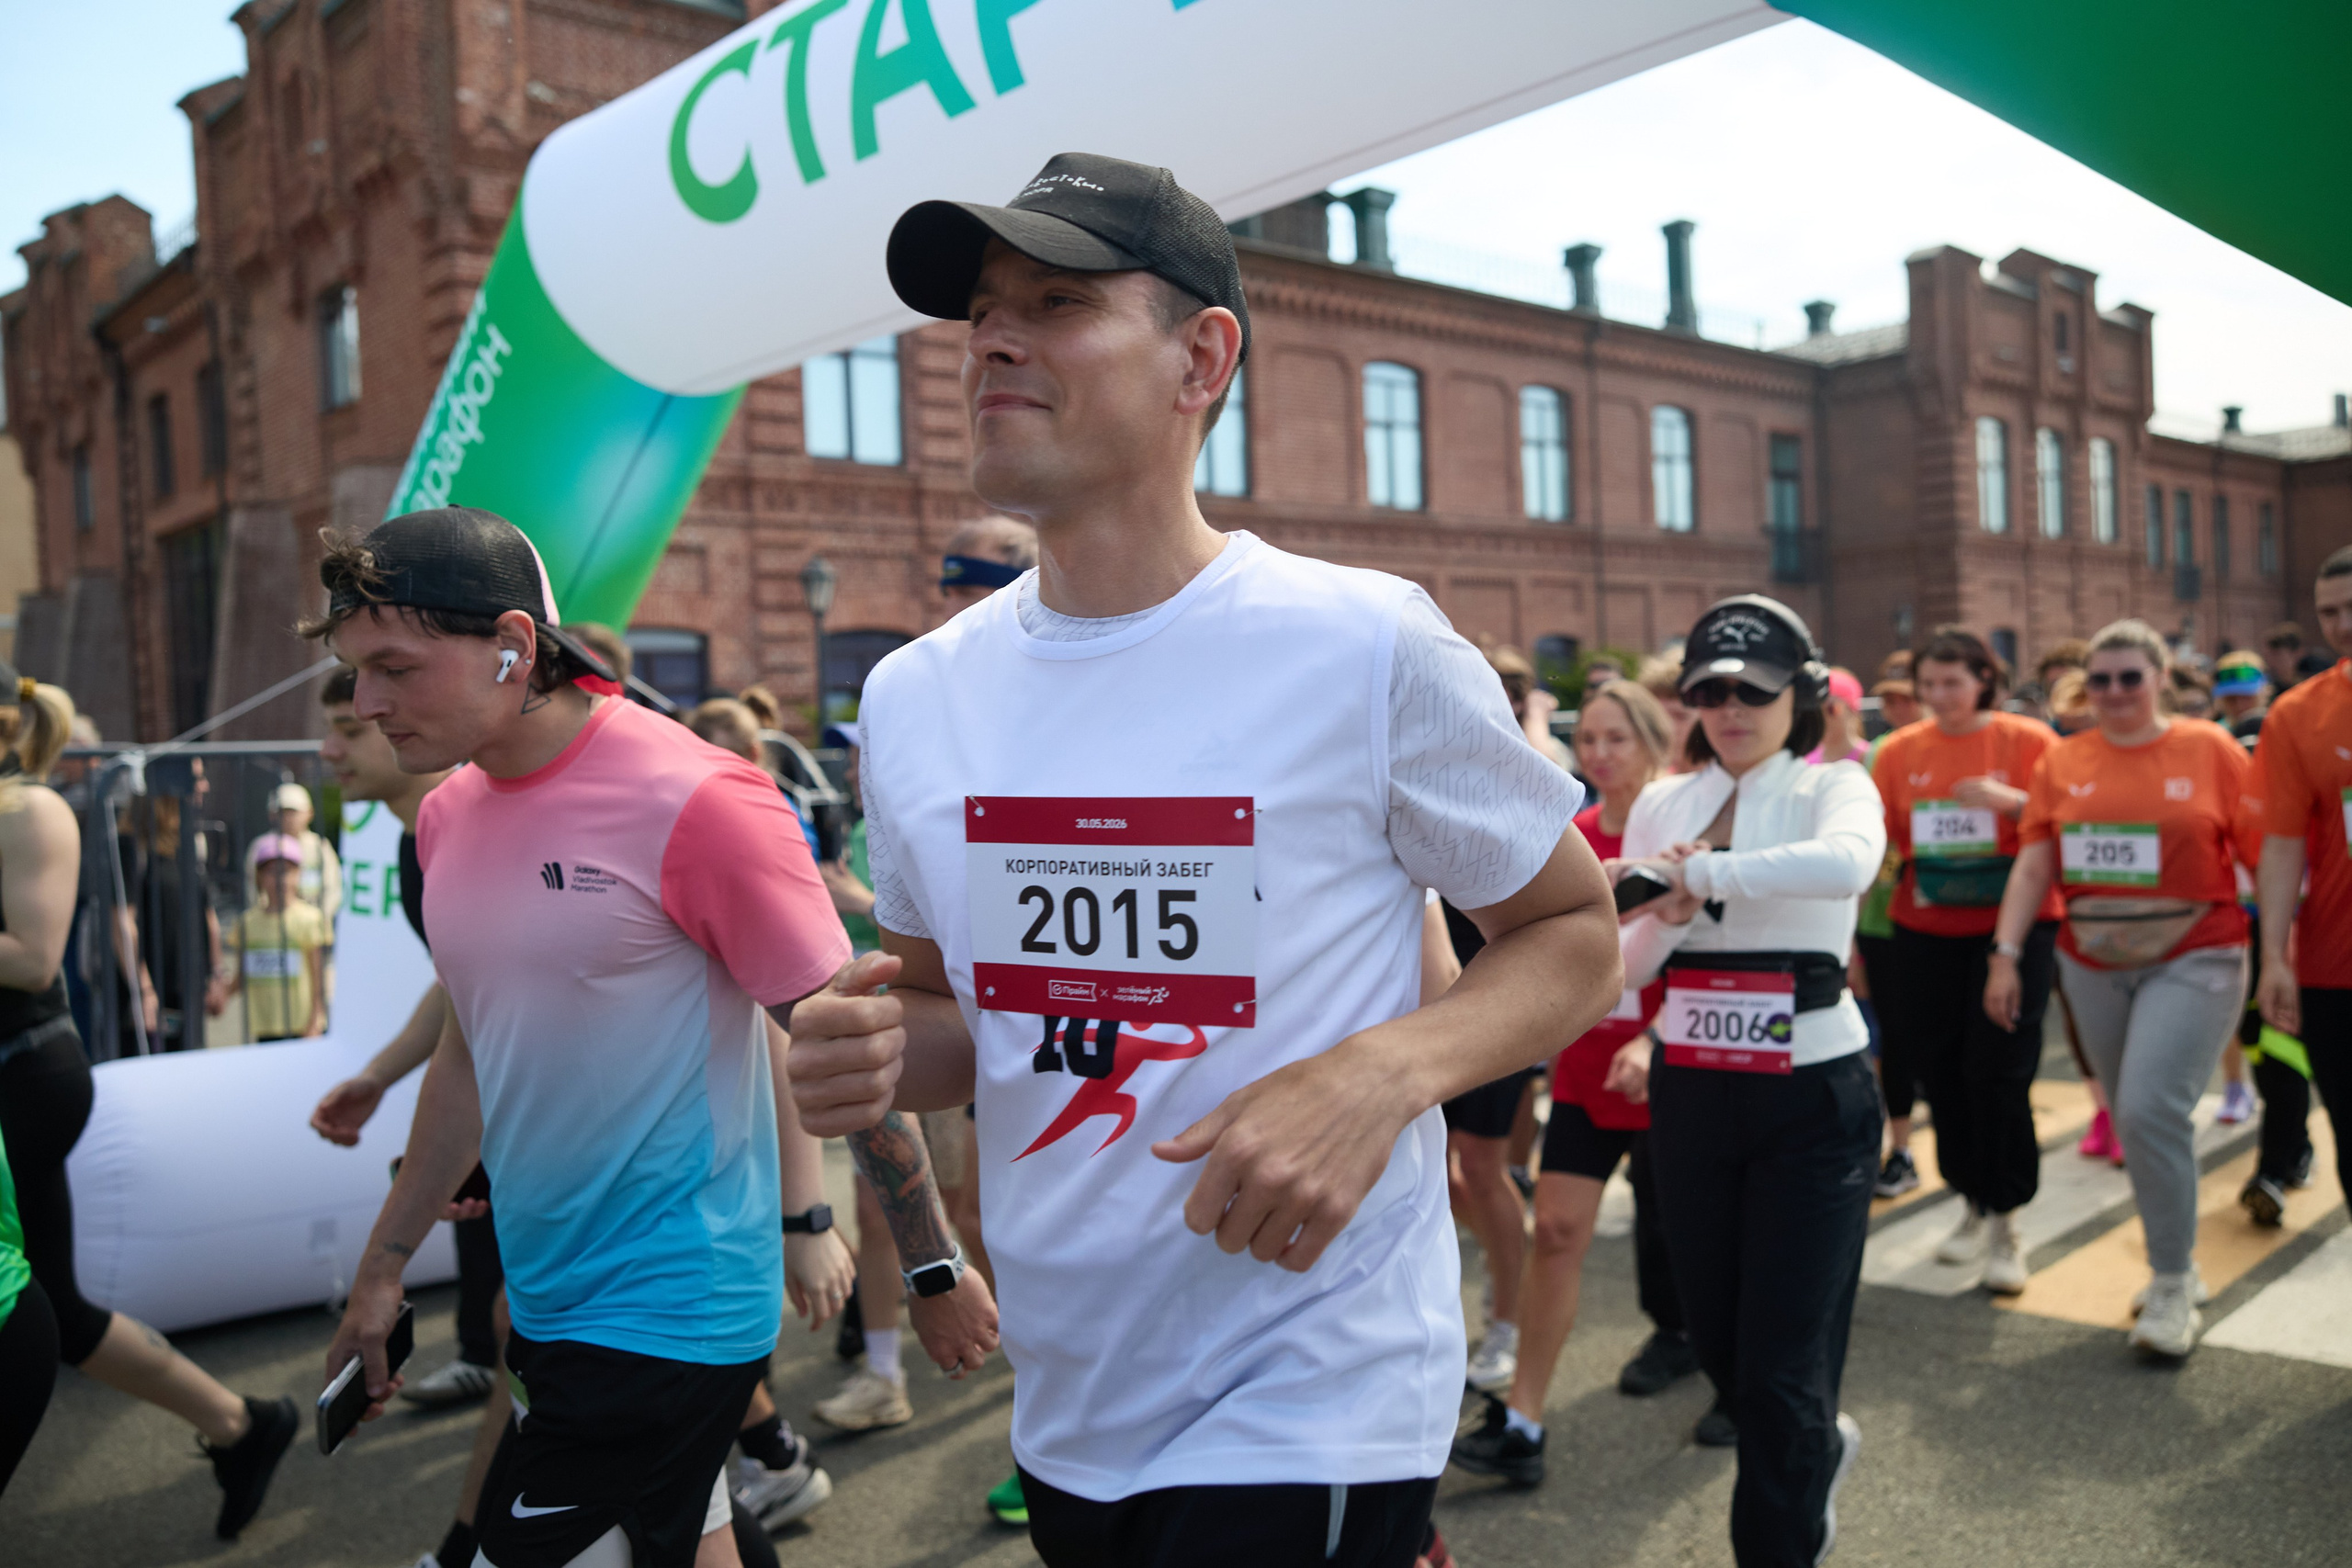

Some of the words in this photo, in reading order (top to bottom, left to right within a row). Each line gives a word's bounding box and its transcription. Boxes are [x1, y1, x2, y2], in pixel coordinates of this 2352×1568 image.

[410, 321, 512, 510] арафон
[1075, 818, 1128, 829] 30.05.2026
[2085, 840, 2137, 866] 205
[1005, 858, 1152, 877] КОРПОРАТИВНЫЙ
[1156, 862, 1214, 878] ЗАБЕГ
[570, 883, 607, 894] Marathon
[572, 874, 617, 886] Vladivostok
[1018, 885, 1199, 961] 2015
[1686, 1008, 1765, 1043] 2006
